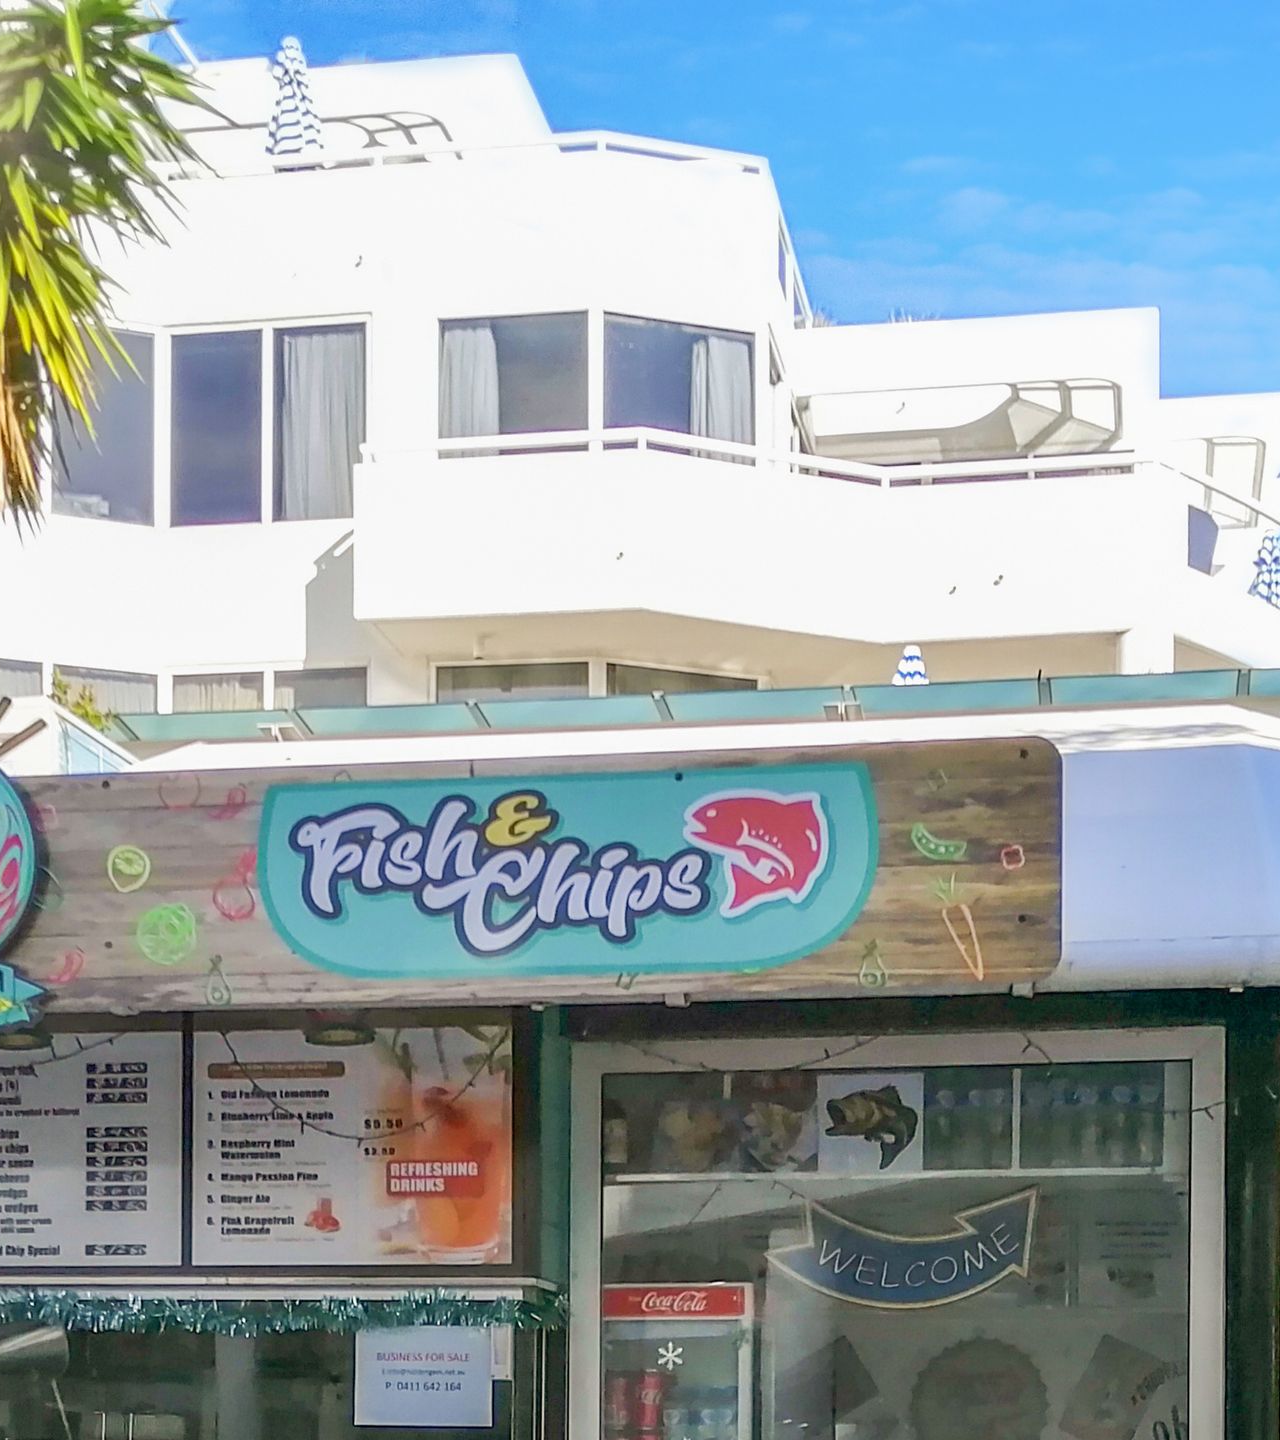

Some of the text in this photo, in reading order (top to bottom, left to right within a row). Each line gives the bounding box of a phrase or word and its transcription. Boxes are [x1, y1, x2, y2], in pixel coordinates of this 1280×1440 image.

[292, 791, 709, 957] Fish & Chips
[390, 1161, 479, 1176] REFRESHING
[390, 1177, 445, 1193] DRINKS
[221, 1216, 241, 1225] Pink
[5, 1245, 25, 1257] Chip
[27, 1245, 61, 1257] Special
[818, 1221, 1020, 1288] WELCOME
[640, 1291, 709, 1312] Coca-Cola
[376, 1352, 470, 1362] BUSINESS FOR SALE
[397, 1381, 420, 1392] 0411
[423, 1381, 441, 1392] 642
[445, 1381, 462, 1392] 164
